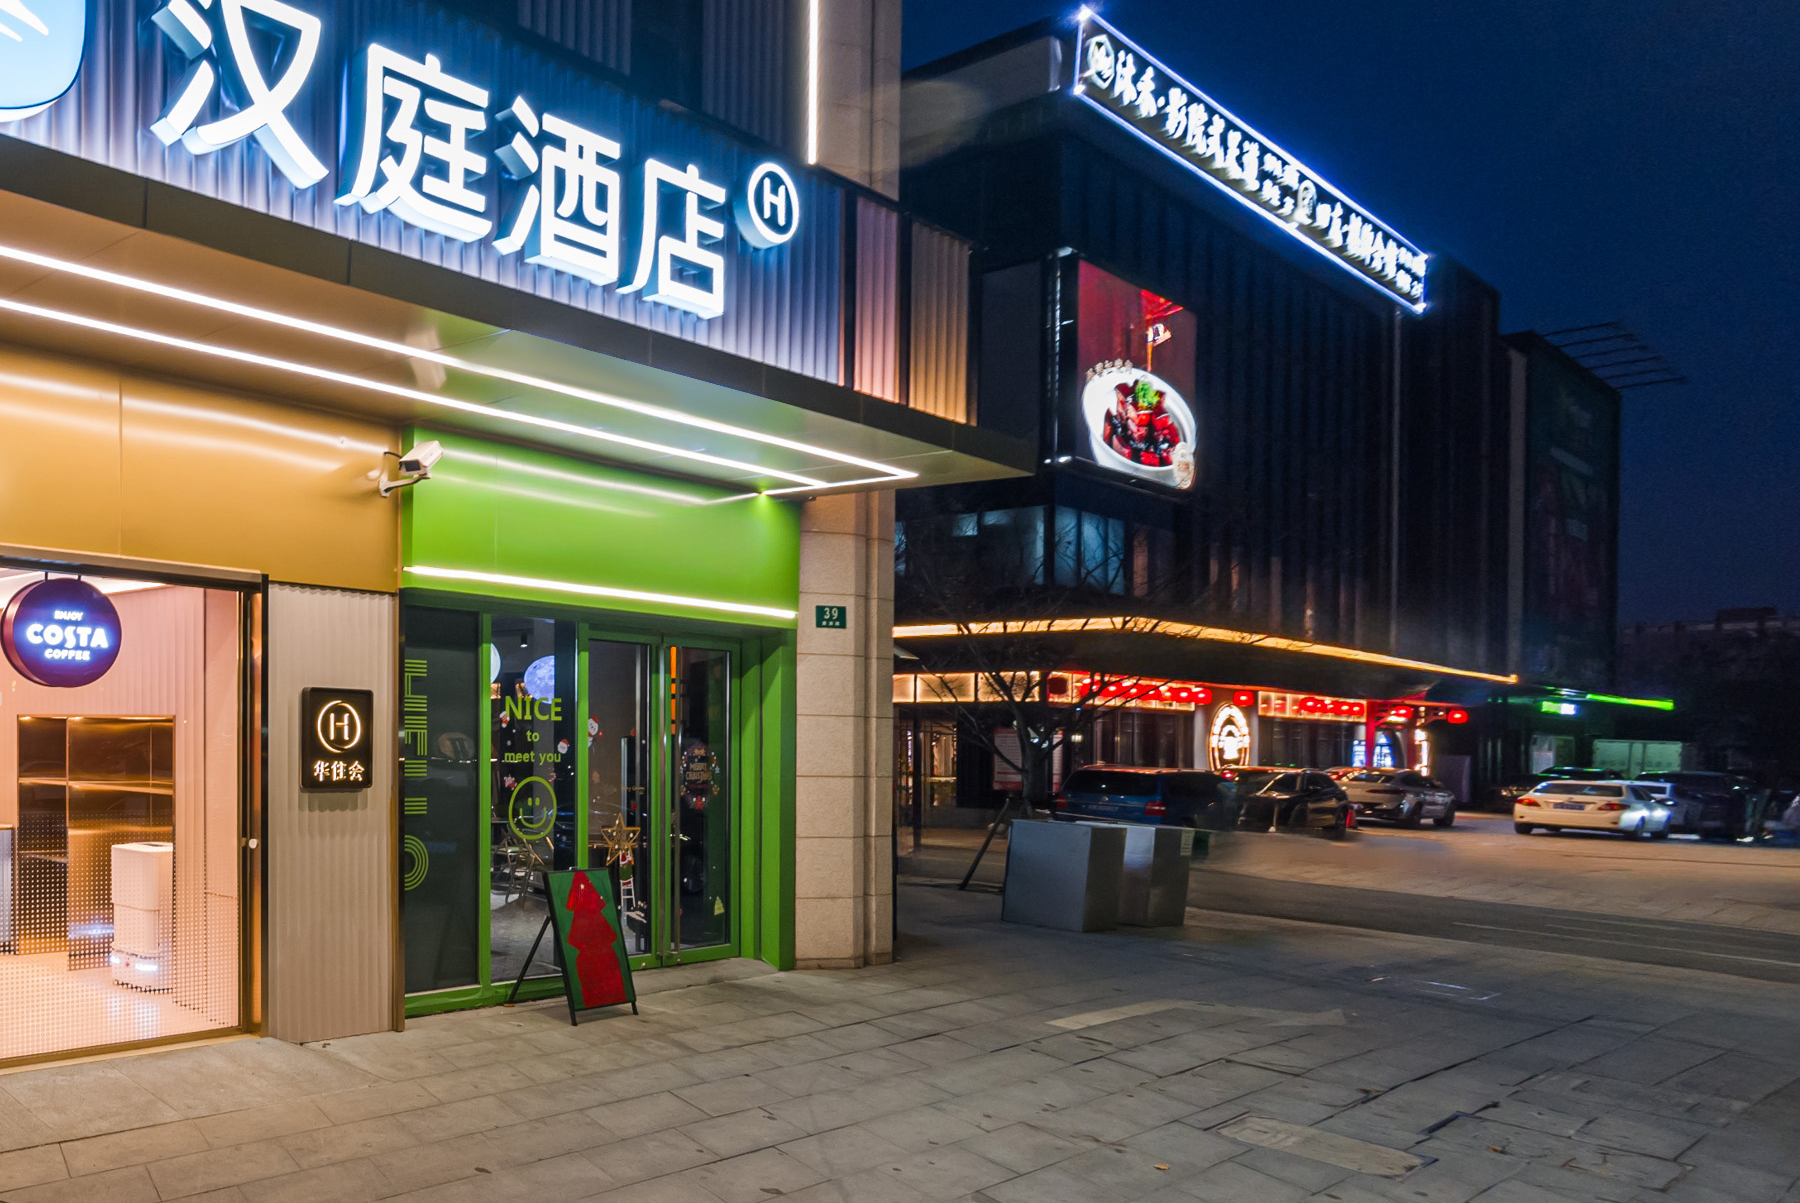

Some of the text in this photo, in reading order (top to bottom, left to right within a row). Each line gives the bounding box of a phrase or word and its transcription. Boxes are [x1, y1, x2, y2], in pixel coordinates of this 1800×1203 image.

[54, 610, 84, 621] ENJOY
[824, 607, 838, 620] 39
[26, 623, 109, 649] COSTA
[44, 648, 90, 661] COFFEE
[504, 696, 562, 721] NICE
[526, 730, 540, 742] to
[504, 750, 561, 766] meet you
[313, 760, 364, 782] 华住会
